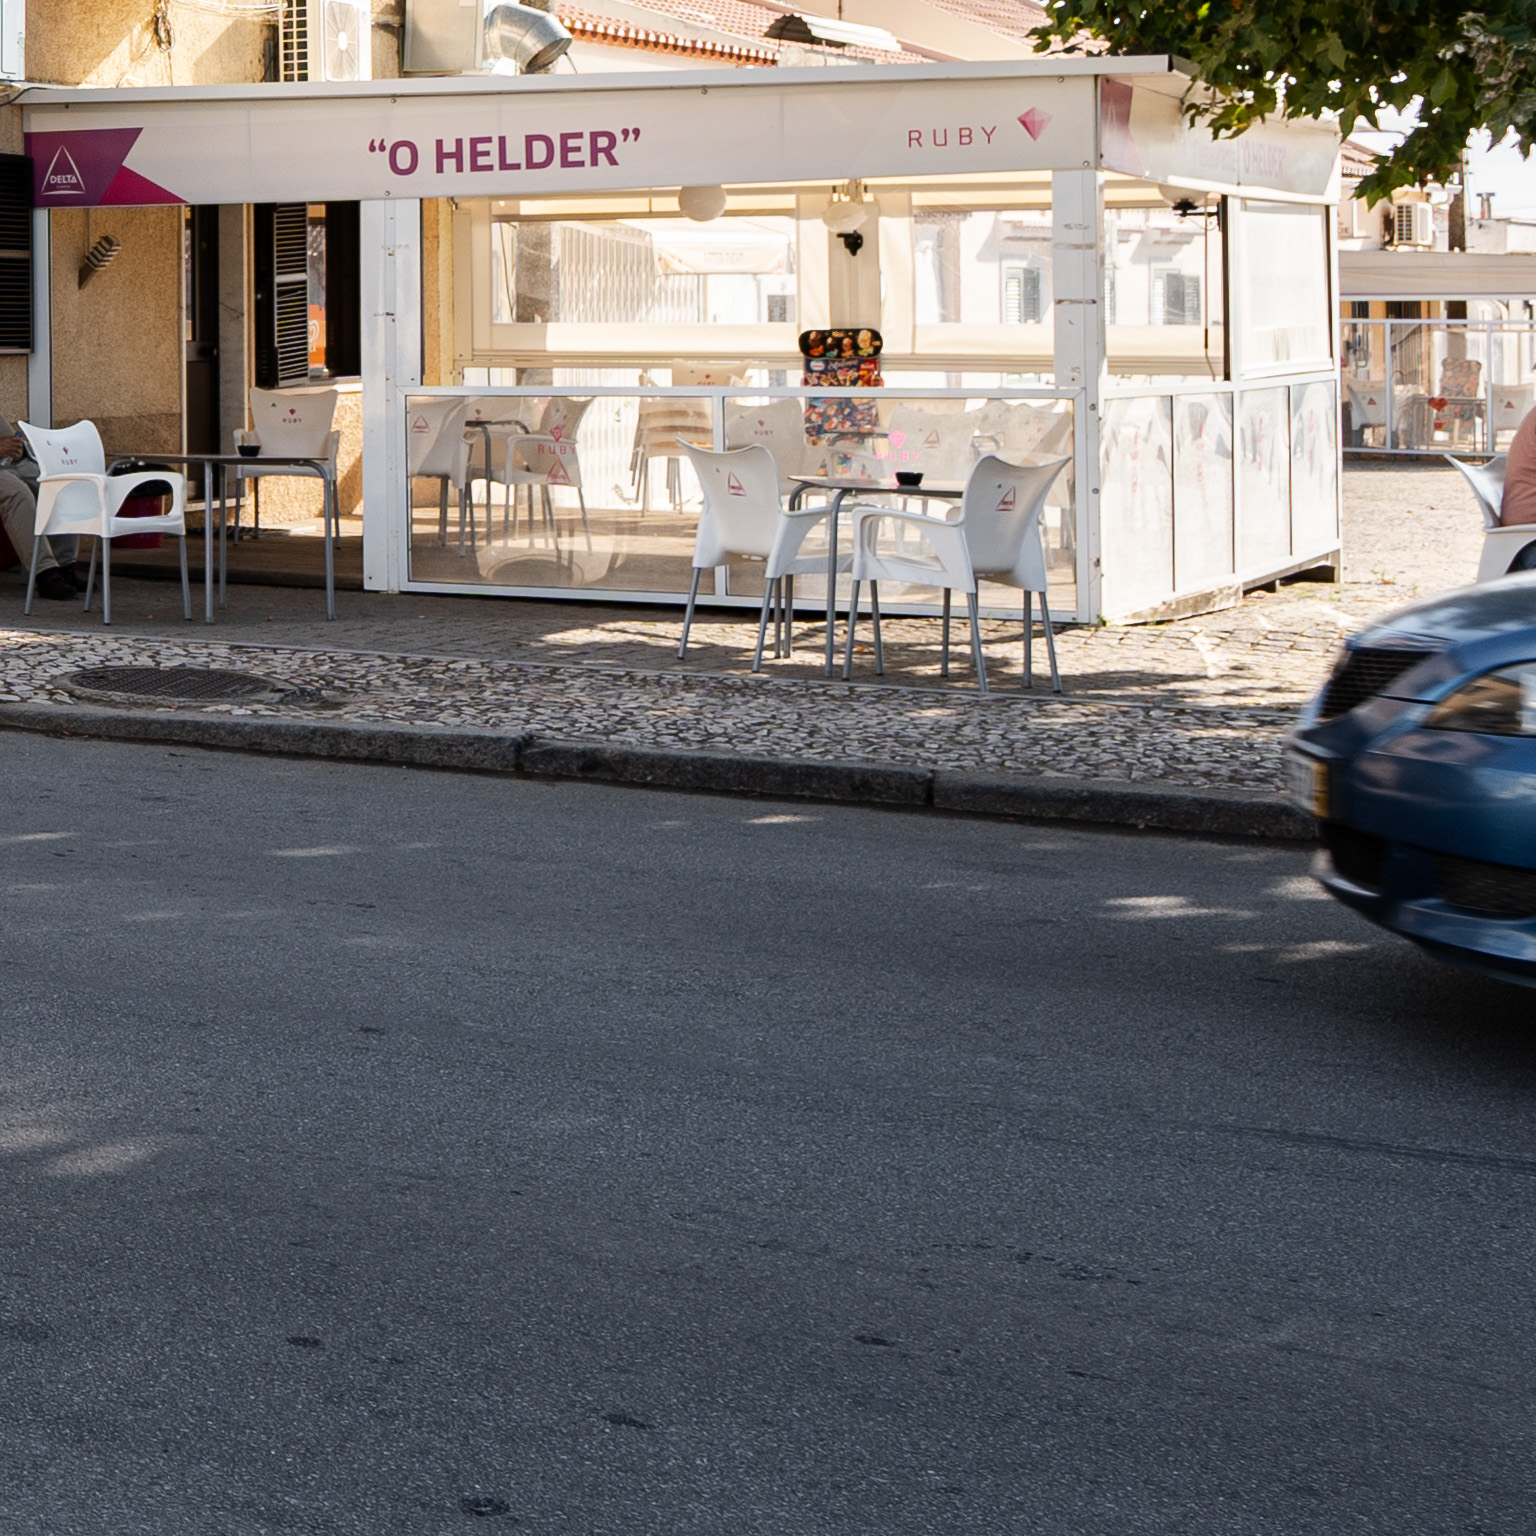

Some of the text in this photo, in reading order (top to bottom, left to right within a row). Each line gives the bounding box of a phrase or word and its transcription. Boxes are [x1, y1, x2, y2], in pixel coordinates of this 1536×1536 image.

[908, 125, 997, 148] RUBY
[50, 175, 77, 184] DELTA
[537, 443, 576, 456] RUBY
[875, 451, 921, 462] RUBY
